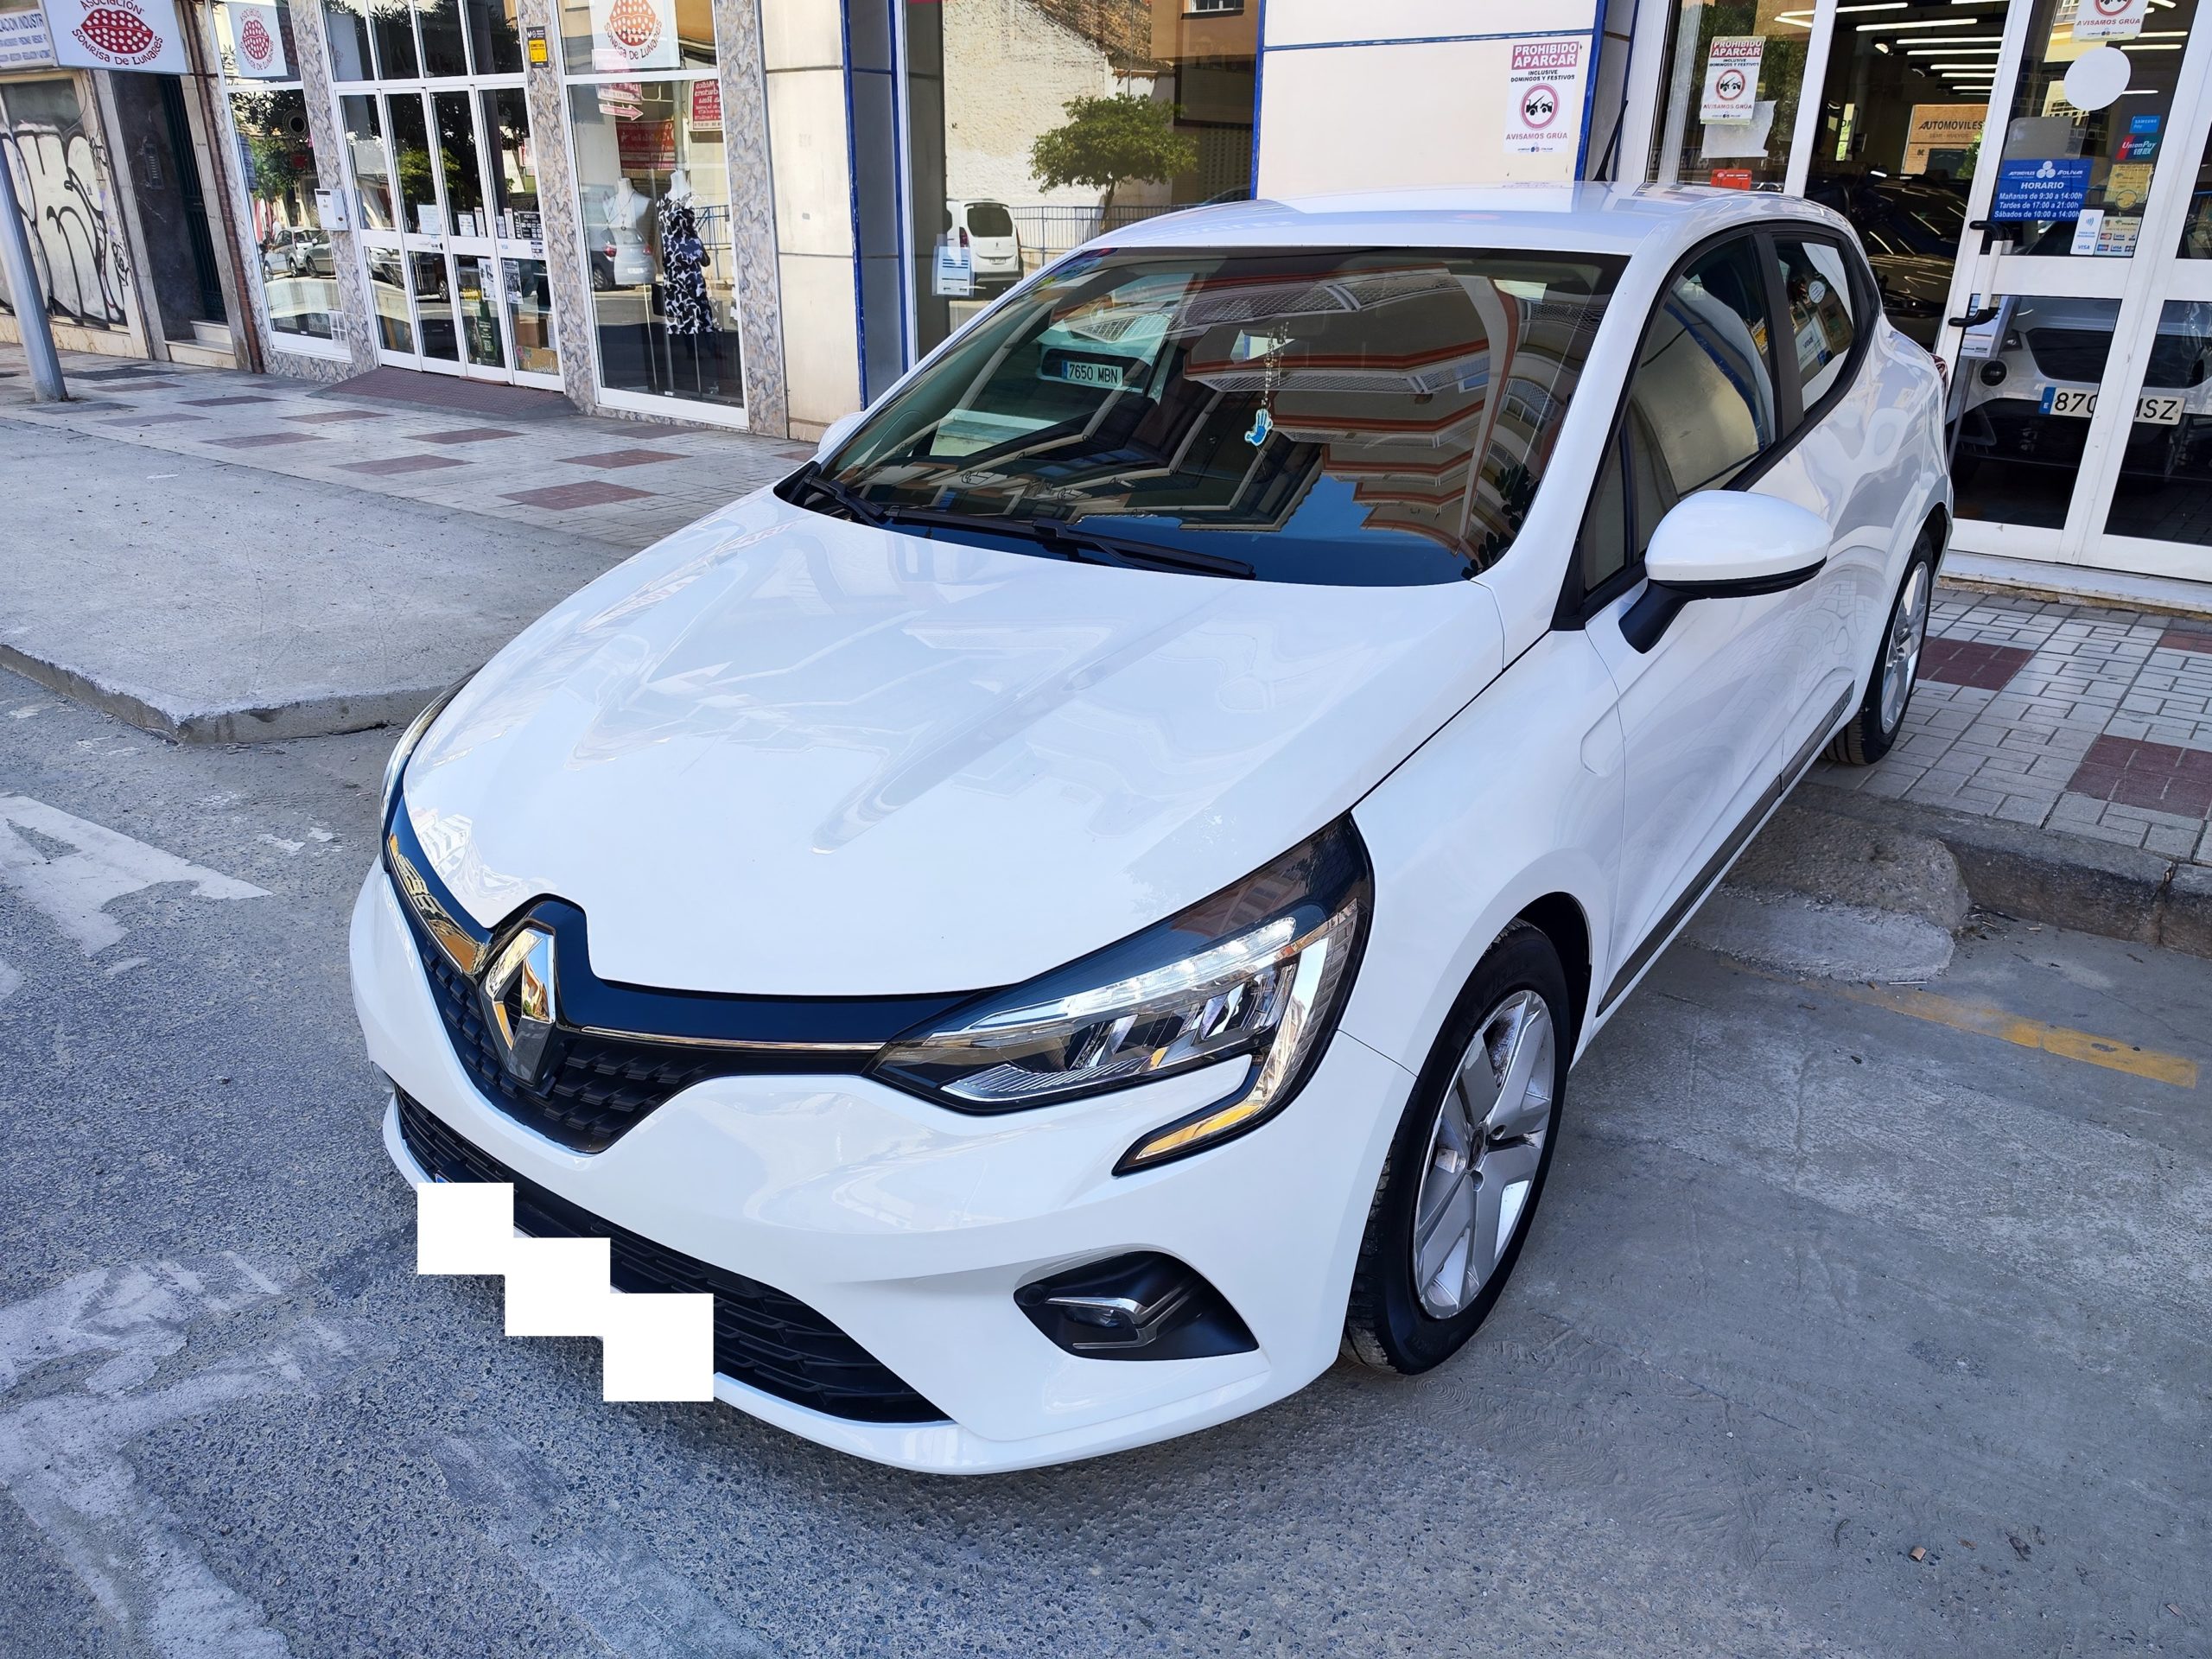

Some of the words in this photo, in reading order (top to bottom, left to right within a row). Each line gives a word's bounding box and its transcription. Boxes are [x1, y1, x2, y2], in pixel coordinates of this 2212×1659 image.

[1515, 42, 1578, 56] PROHIBIDO
[1713, 48, 1761, 56] APARCAR
[114, 56, 130, 65] De
[1514, 54, 1576, 67] APARCAR
[2122, 141, 2158, 150] UnionPay
[1069, 364, 1094, 381] 7650
[1097, 367, 1118, 384] MBN
